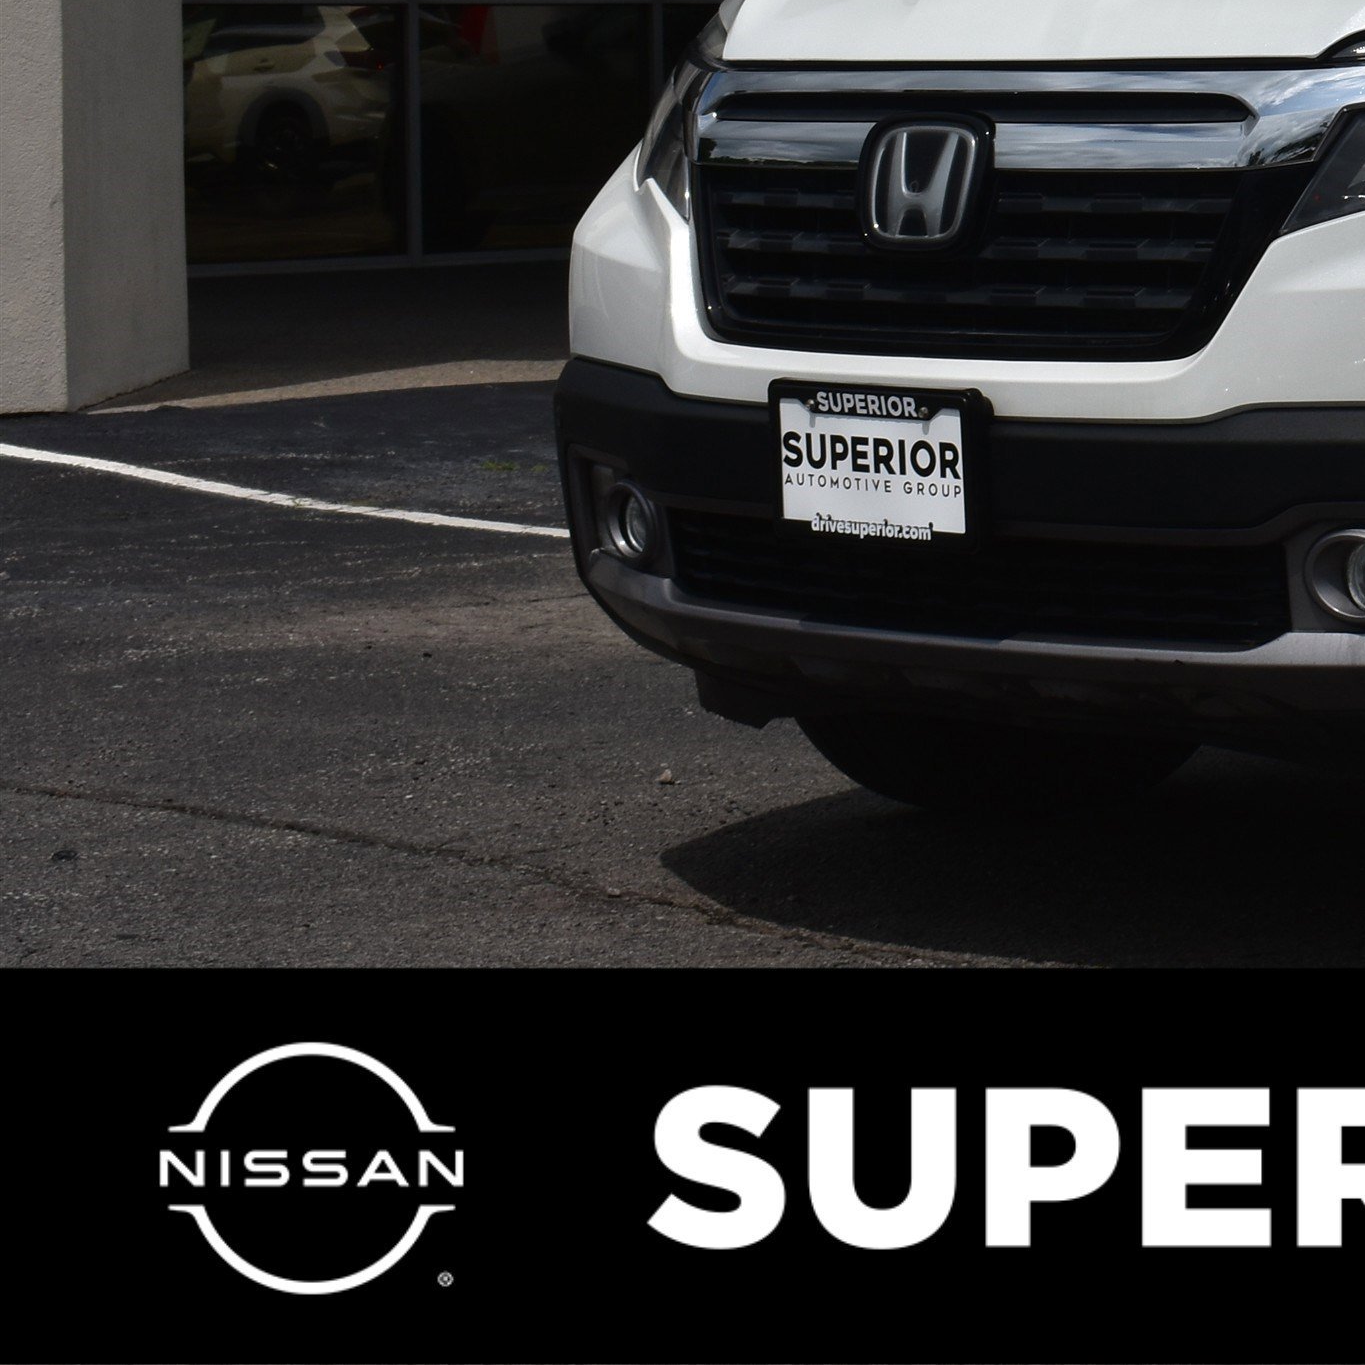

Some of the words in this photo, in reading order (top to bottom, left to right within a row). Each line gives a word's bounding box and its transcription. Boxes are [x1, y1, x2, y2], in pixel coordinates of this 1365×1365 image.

[816, 391, 918, 418] SUPERIOR
[782, 431, 962, 480] SUPERIOR
[784, 473, 892, 493] AUTOMOTIVE
[903, 481, 962, 498] GROUP
[811, 512, 932, 541] drivesuperior.com
